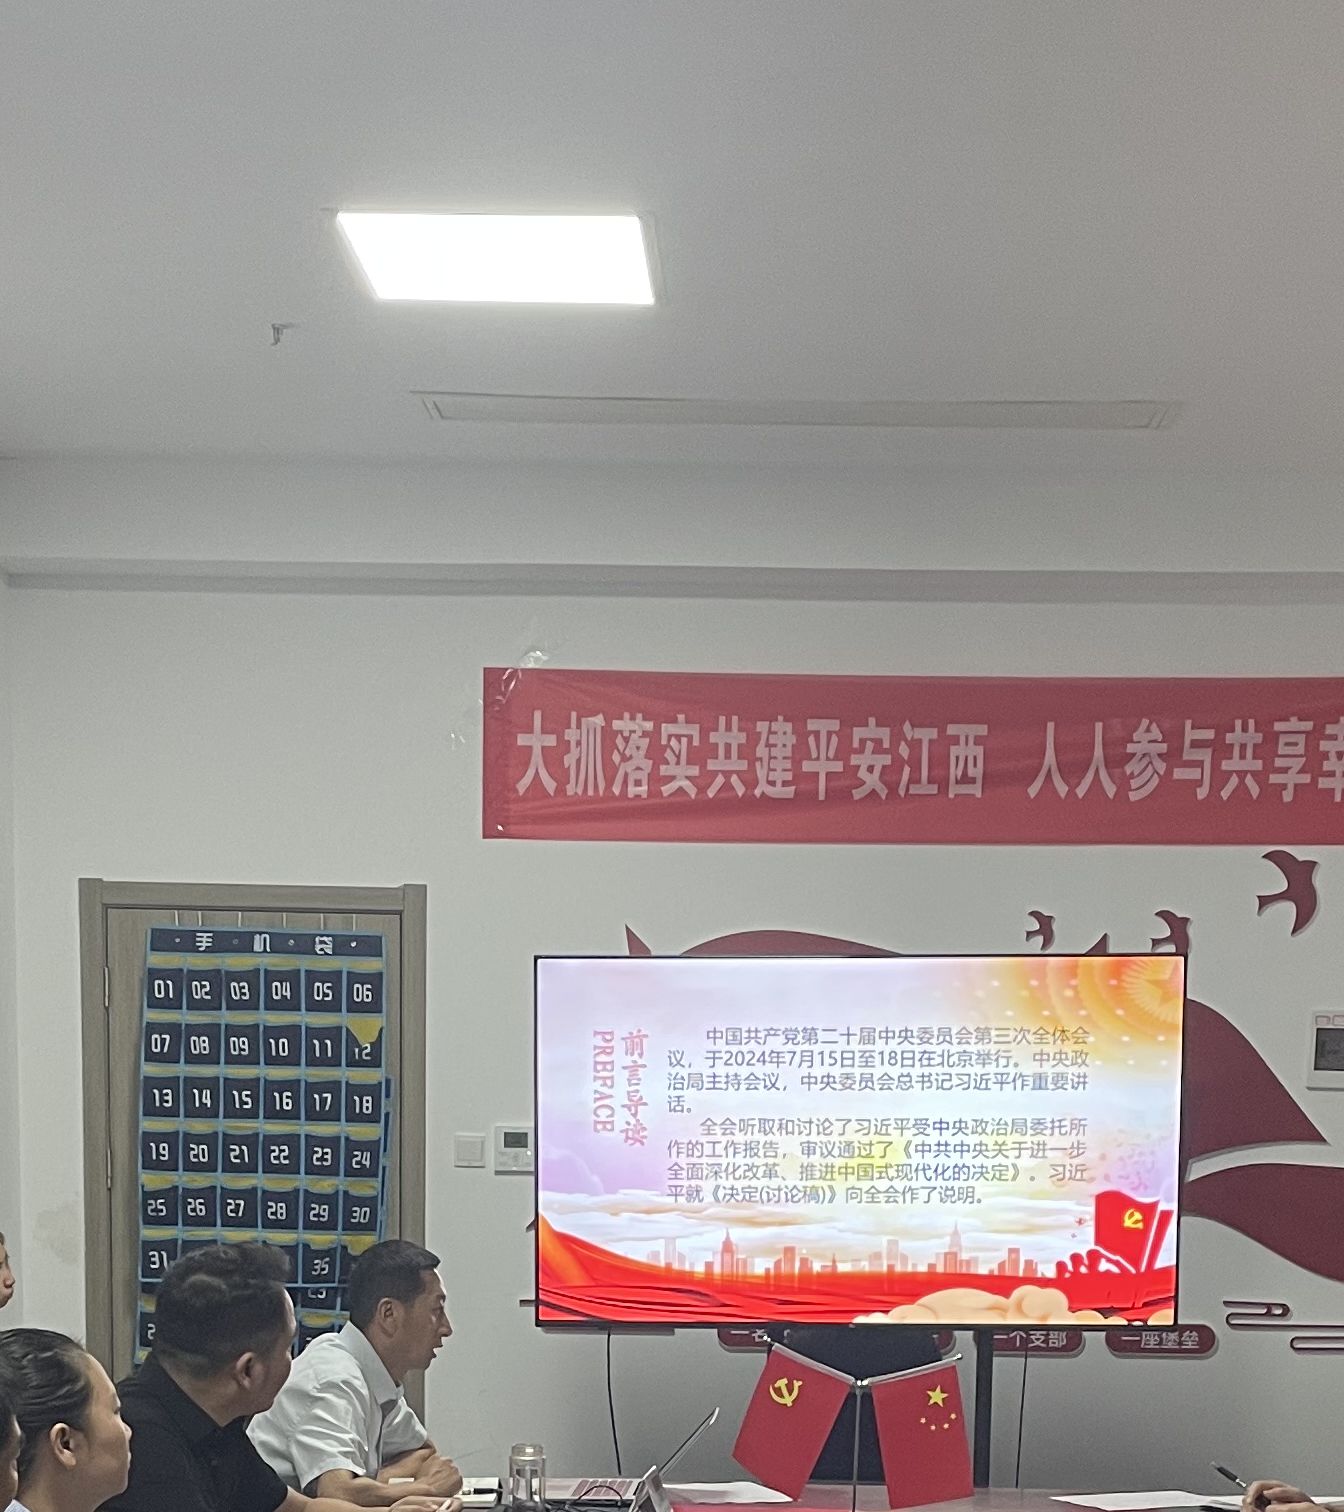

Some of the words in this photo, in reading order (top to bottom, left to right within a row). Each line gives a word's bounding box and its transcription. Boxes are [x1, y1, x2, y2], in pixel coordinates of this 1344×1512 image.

[516, 710, 988, 800] 大抓落实共建平安江西
[154, 979, 174, 999] 01
[191, 980, 212, 1000] 02
[230, 981, 250, 1000] 03
[271, 981, 291, 1000] 04
[313, 981, 333, 1001] 05
[353, 983, 373, 1003] 06
[151, 1033, 171, 1053] 07
[190, 1035, 210, 1055] 08
[229, 1036, 249, 1056] 09
[269, 1038, 289, 1057] 10
[312, 1039, 332, 1058] 11
[707, 1026, 1089, 1046] 中国共产党第二十届中央委员会第三次全体会
[668, 1049, 1089, 1069] 议，于2024年7月15日至18日在北京举行。中央政
[592, 1030, 615, 1135] PREFACE
[620, 1029, 649, 1147] 前言导读
[668, 1072, 1088, 1092] 治局主持会议，中央委员会总书记习近平作重要讲
[152, 1088, 173, 1108] 13
[192, 1088, 211, 1108] 14
[232, 1090, 252, 1109] 15
[273, 1091, 293, 1111] 16
[313, 1092, 332, 1112] 17
[353, 1095, 373, 1114] 18
[668, 1095, 693, 1114] 话。
[700, 1117, 1087, 1137] 全会听取和讨论了习近平受中央政治局委托所
[149, 1142, 169, 1161] 19
[189, 1143, 209, 1163] 20
[229, 1144, 249, 1163] 21
[270, 1145, 290, 1165] 22
[312, 1147, 332, 1166] 23
[351, 1151, 371, 1169] 24
[668, 1140, 1086, 1160] 作的工作报告，审议通过了《中共中央关于进一步
[667, 1162, 1087, 1183] 全面深化改革、推进中国式现代化的决定》。习近
[147, 1198, 167, 1216] 25
[187, 1198, 206, 1216] 26
[226, 1198, 245, 1217] 27
[267, 1201, 287, 1220] 28
[309, 1203, 329, 1222] 29
[350, 1206, 371, 1224] 30
[148, 1250, 168, 1270] 31
[311, 1257, 330, 1275] 35
[146, 1323, 157, 1339] 2
[993, 1330, 1067, 1349] 一个支部
[1121, 1331, 1199, 1349] 一座堡垒
